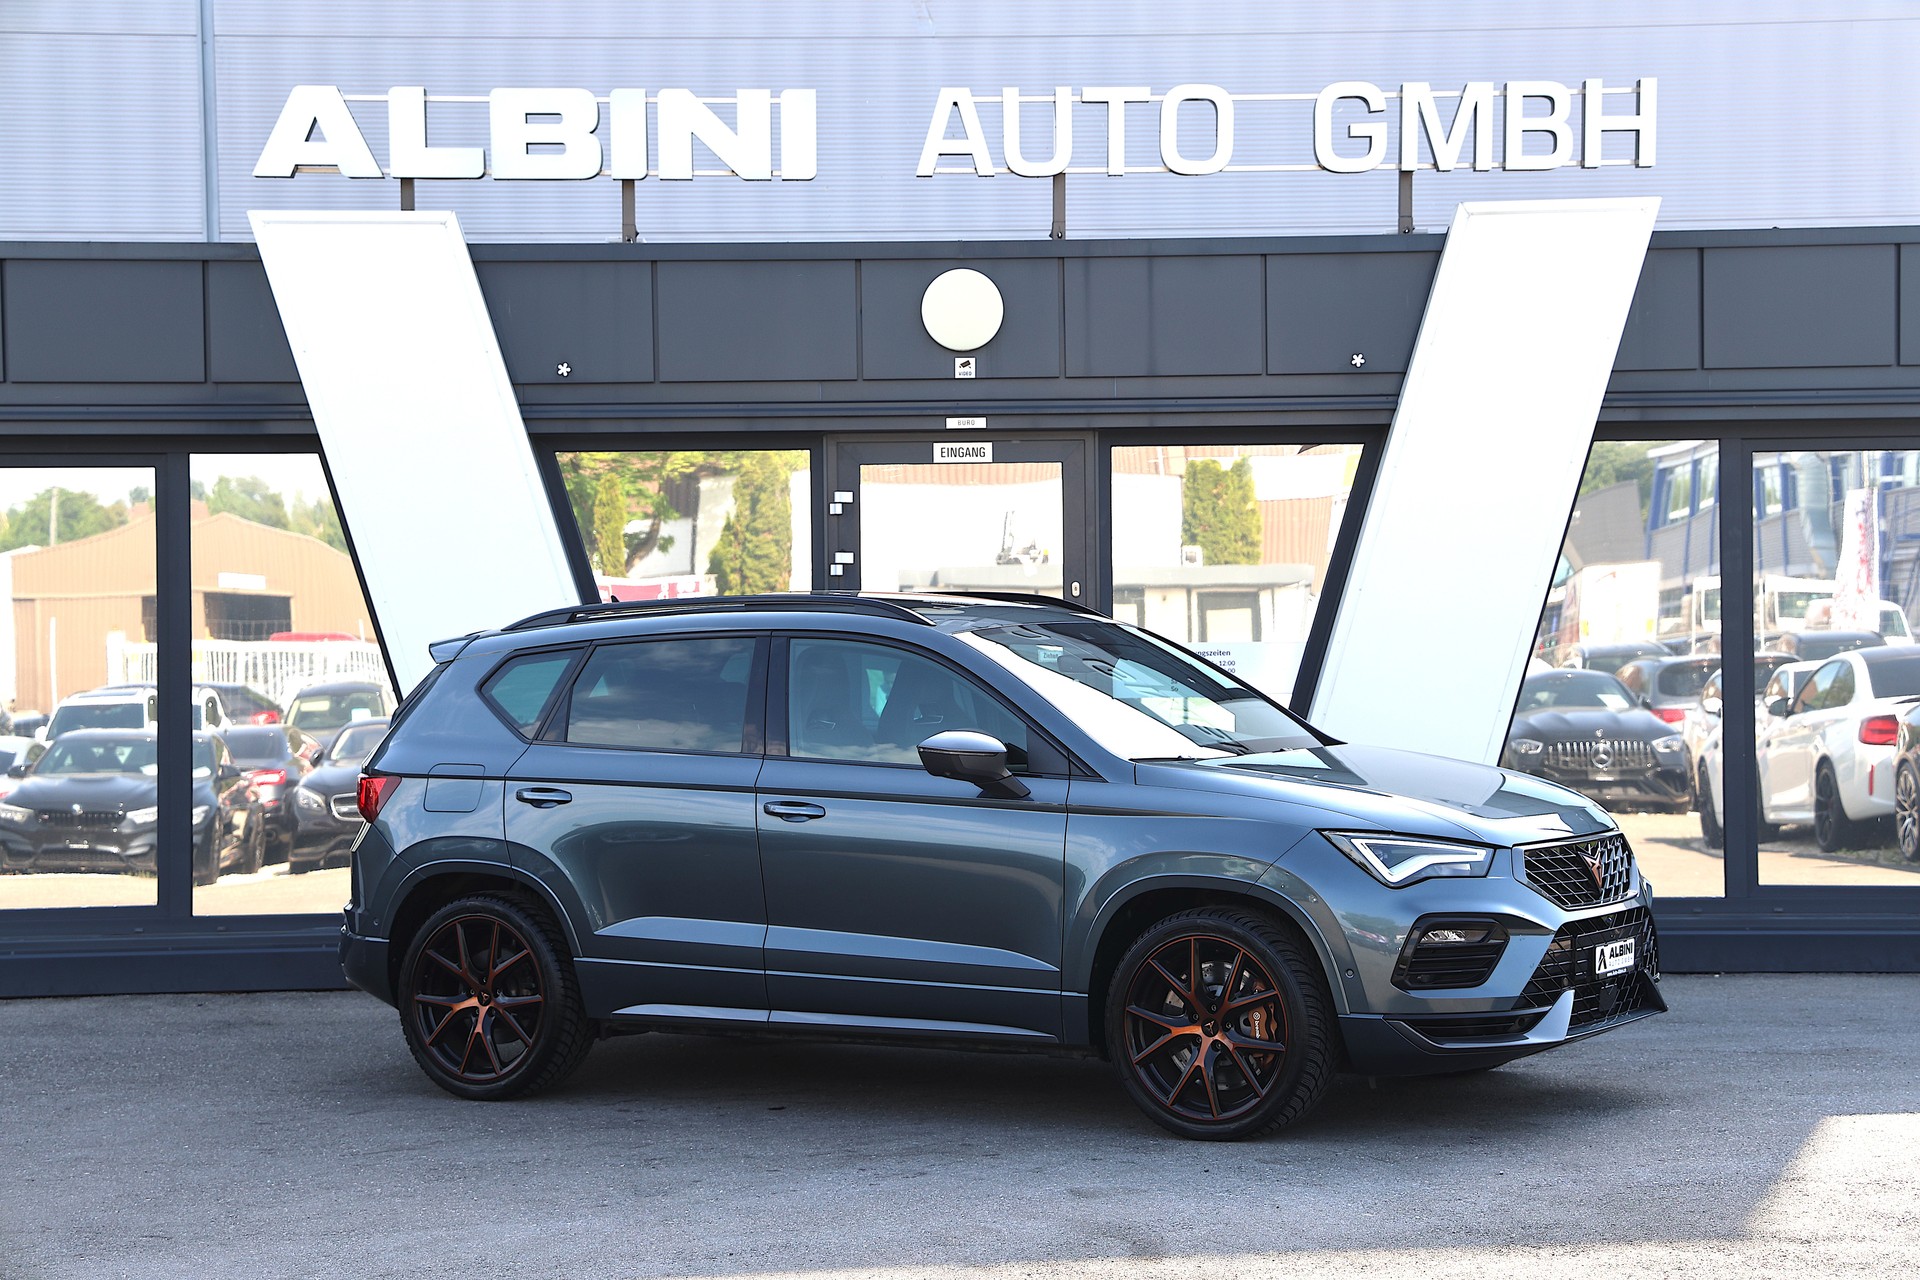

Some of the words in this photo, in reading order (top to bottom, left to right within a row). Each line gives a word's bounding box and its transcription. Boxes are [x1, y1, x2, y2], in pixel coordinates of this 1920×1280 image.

[252, 85, 817, 181] ALBINI
[916, 84, 1234, 178] AUTO
[1313, 77, 1657, 174] GMBH
[940, 447, 986, 458] EINGANG
[1609, 942, 1633, 959] ALBINI
